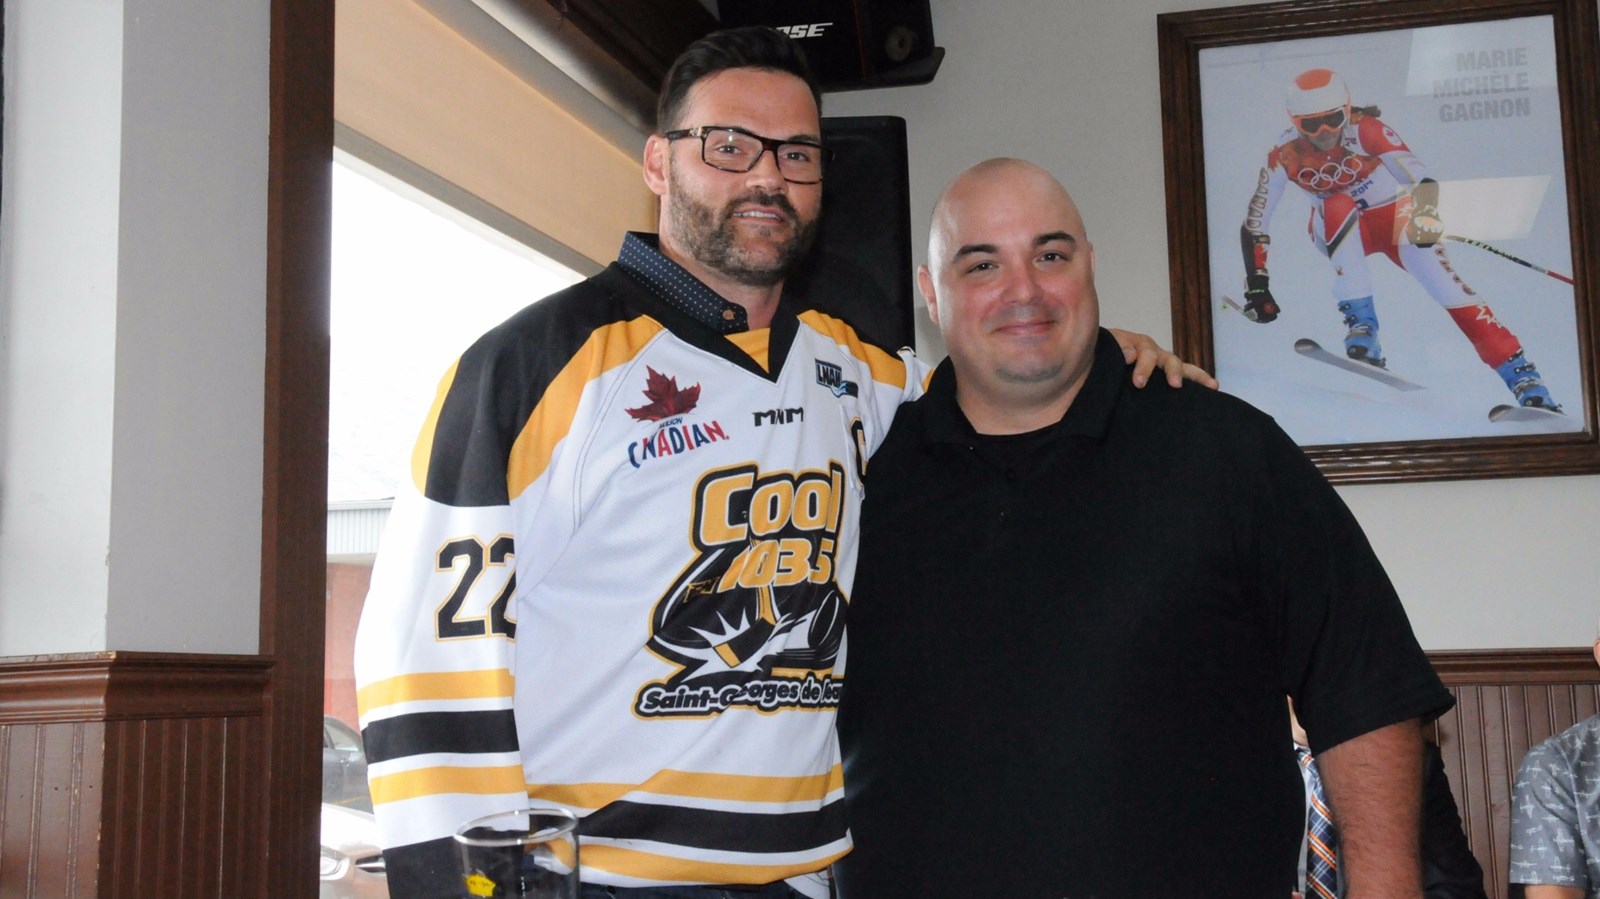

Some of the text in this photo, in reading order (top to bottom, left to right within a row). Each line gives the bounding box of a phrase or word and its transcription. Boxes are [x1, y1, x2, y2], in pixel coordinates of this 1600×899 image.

[1456, 47, 1528, 71] MARIE
[1432, 70, 1530, 98] MICHÈLE
[1439, 97, 1531, 122] GAGNON
[696, 466, 844, 549] Cool
[435, 534, 516, 643] 22
[801, 676, 822, 703] de
